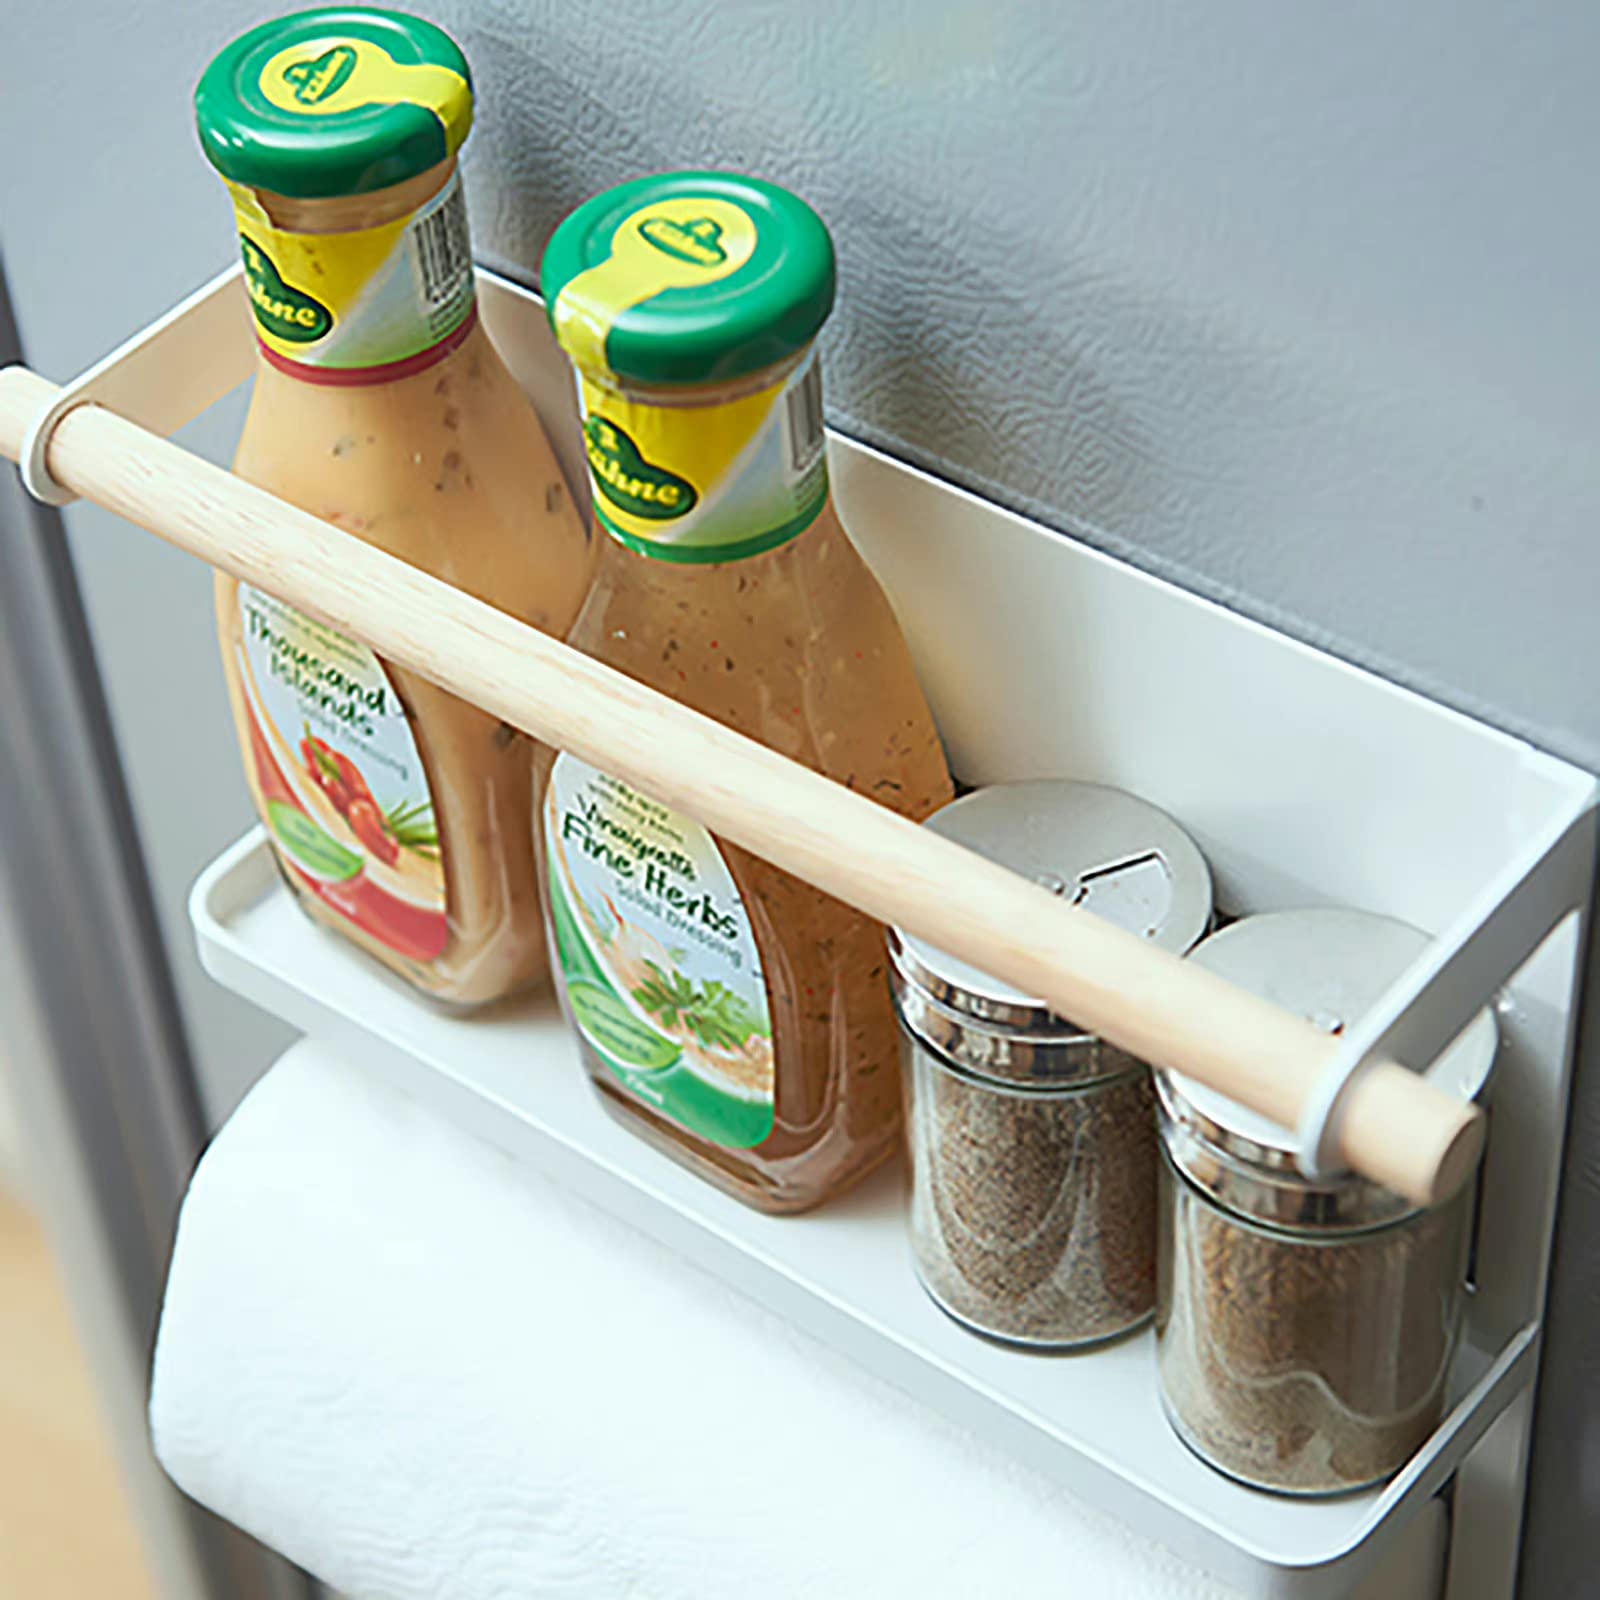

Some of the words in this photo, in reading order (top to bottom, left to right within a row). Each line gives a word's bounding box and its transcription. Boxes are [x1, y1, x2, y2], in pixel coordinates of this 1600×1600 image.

[244, 603, 386, 716] Thousand
[271, 652, 375, 737] Islands
[563, 812, 635, 878] Fine
[644, 863, 738, 940] Herbs
